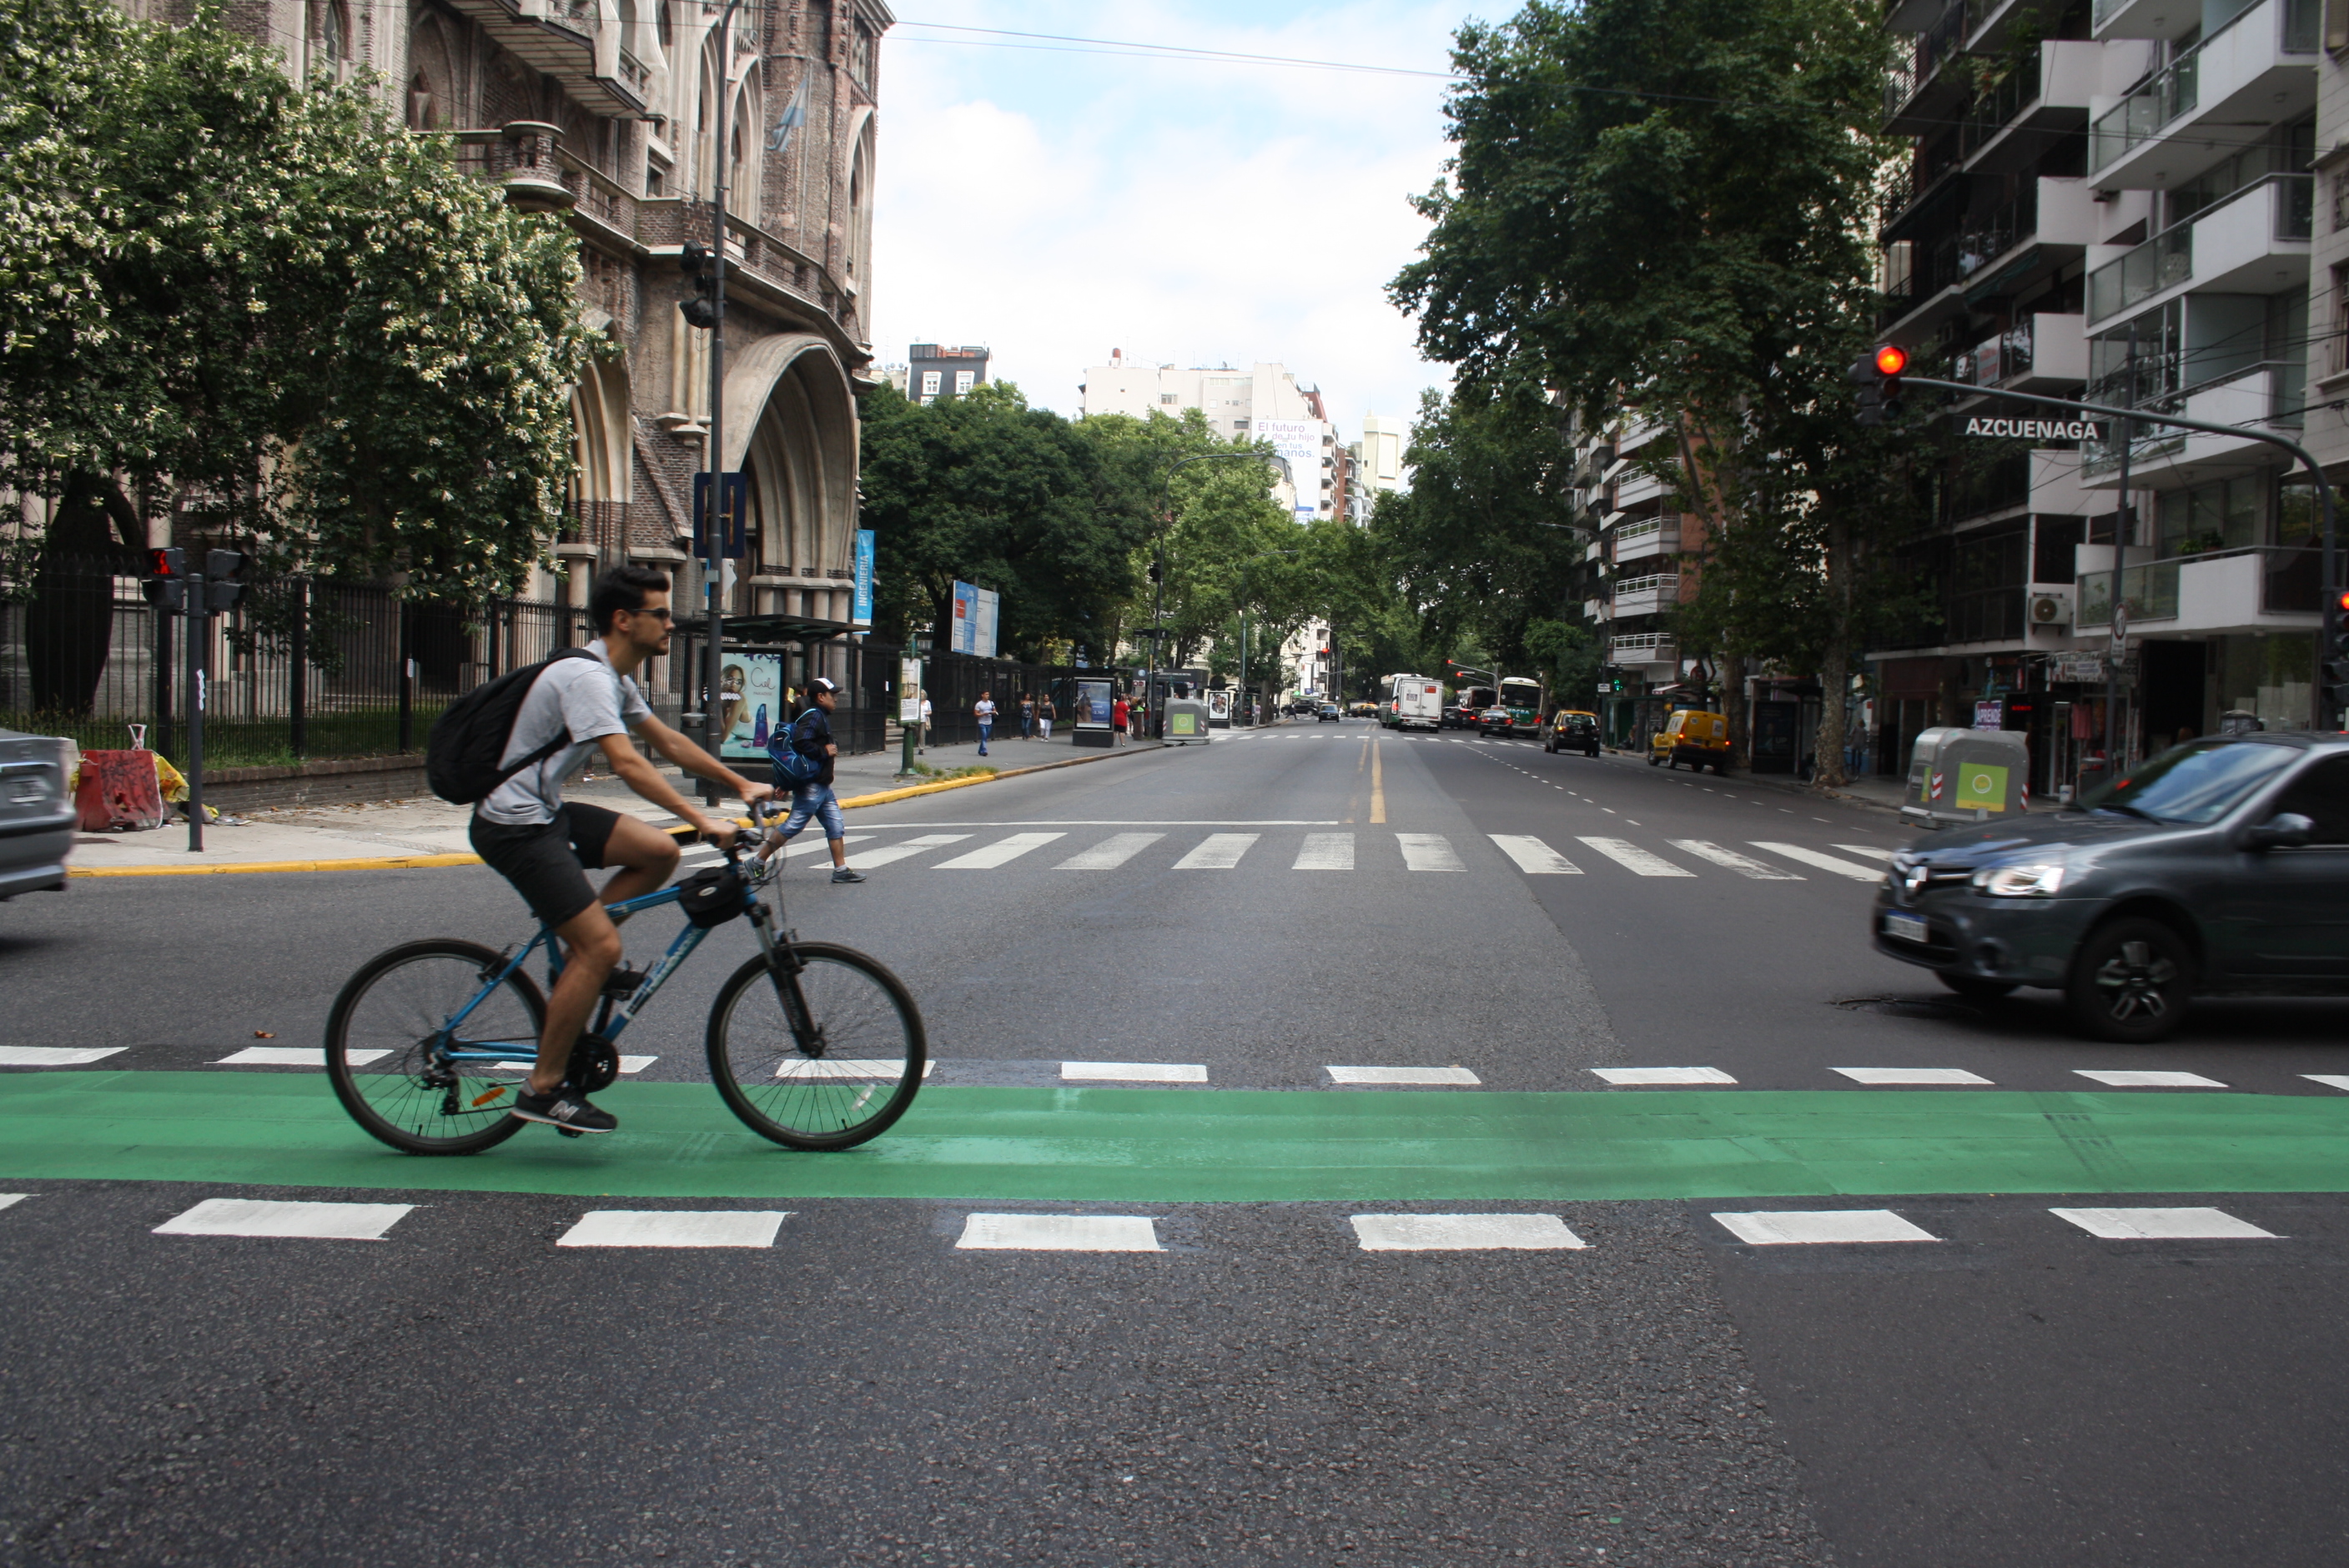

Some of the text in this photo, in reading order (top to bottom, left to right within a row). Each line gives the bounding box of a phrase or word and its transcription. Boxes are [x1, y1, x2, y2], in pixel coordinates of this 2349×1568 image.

[1258, 422, 1305, 432] El futuro
[1965, 418, 2099, 440] AZCUENAGA
[1299, 433, 1315, 442] hijo
[858, 555, 869, 606] INGENIERIA
